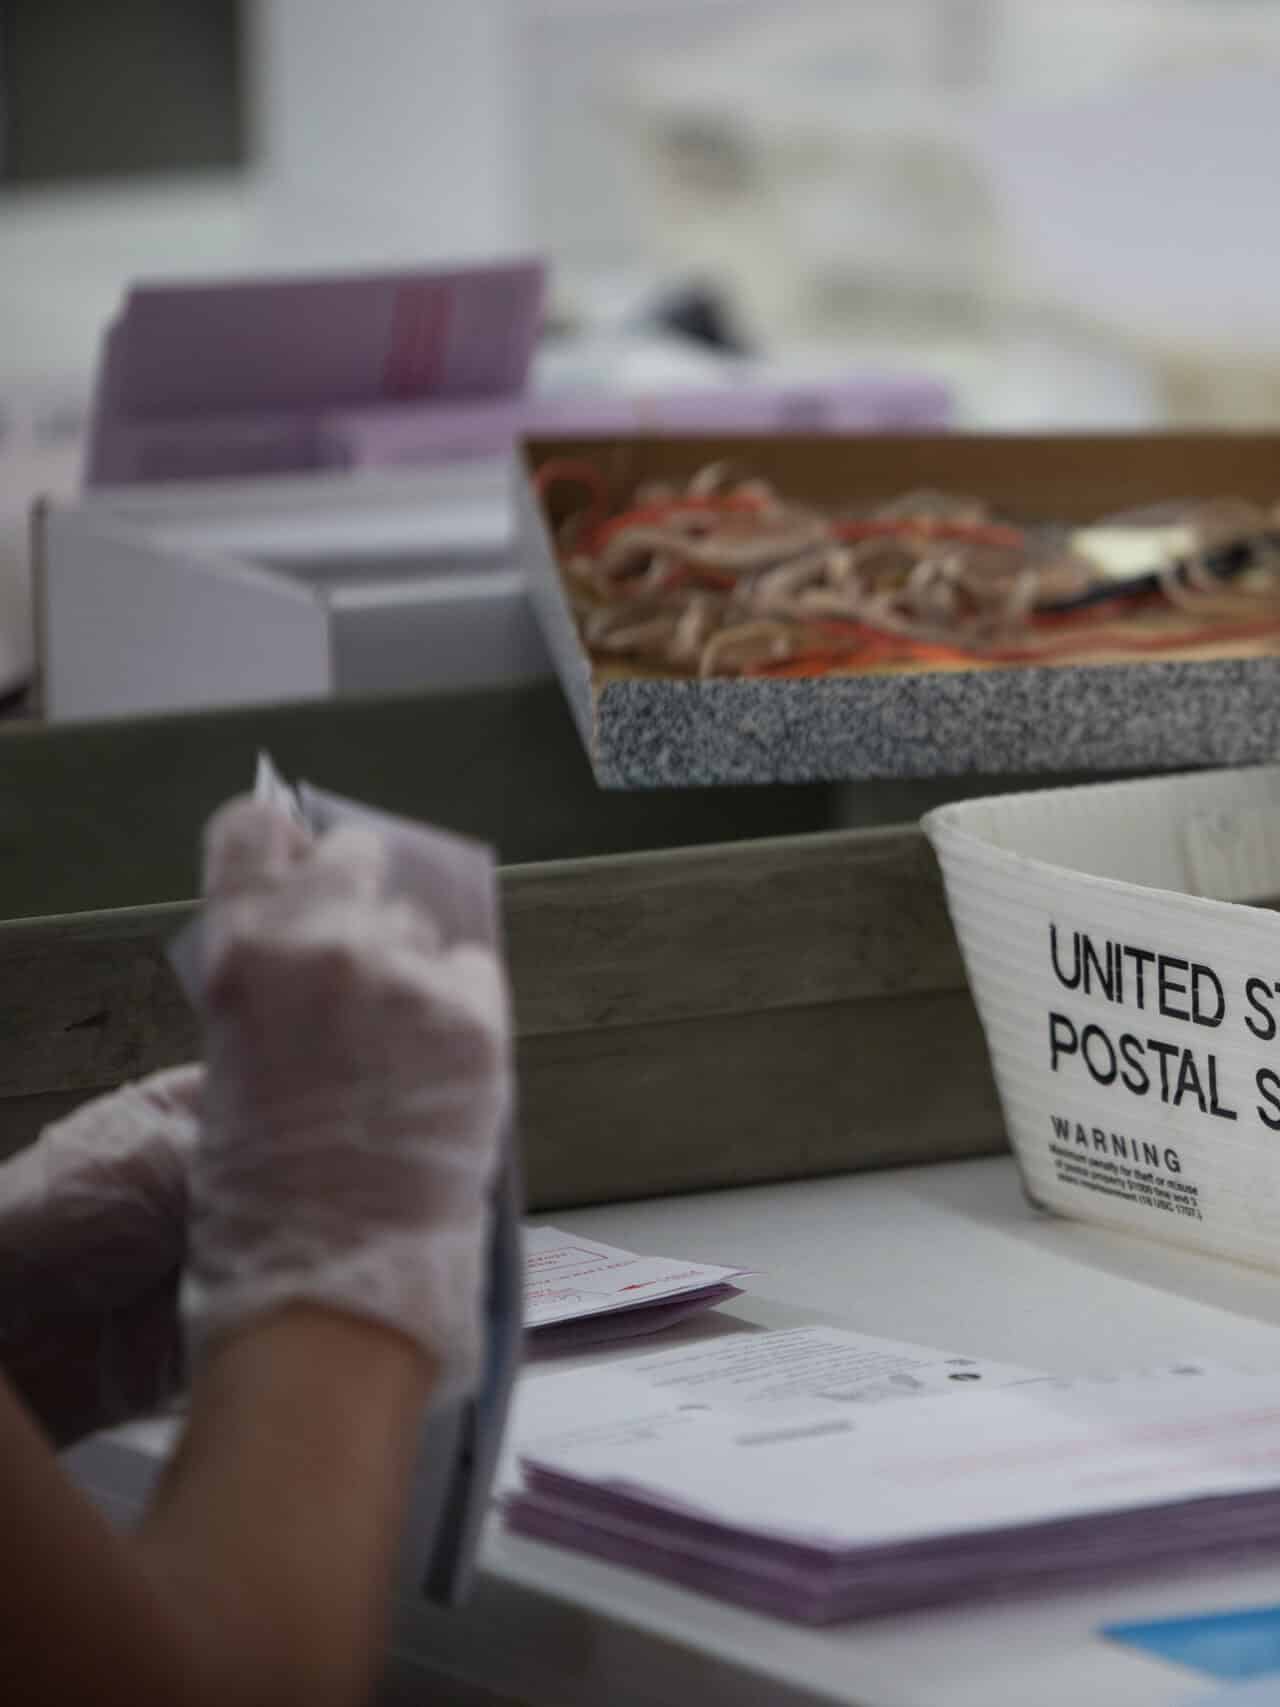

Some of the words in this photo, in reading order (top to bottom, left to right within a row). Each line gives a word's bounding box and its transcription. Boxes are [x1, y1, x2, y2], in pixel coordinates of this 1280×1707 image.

[1049, 922, 1226, 1028] UNITED
[1049, 1011, 1237, 1120] POSTAL
[1051, 1115, 1182, 1173] WARNING
